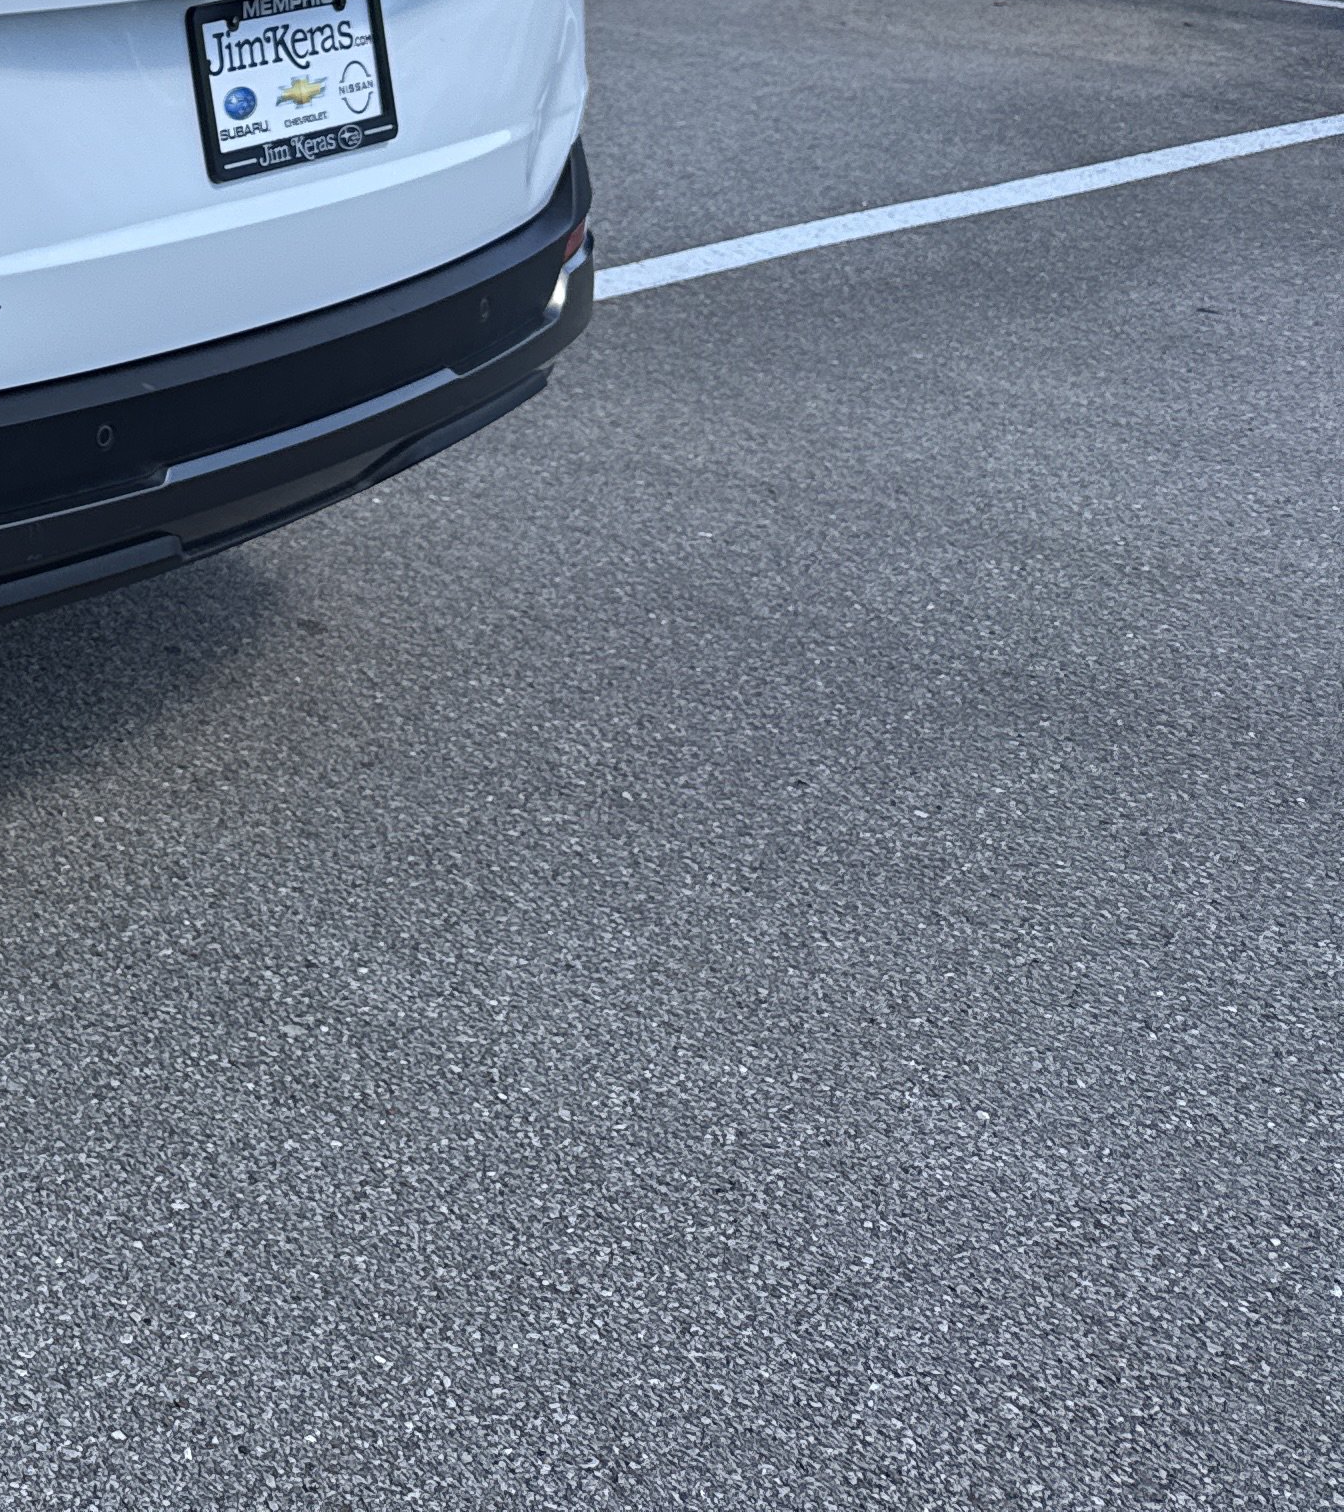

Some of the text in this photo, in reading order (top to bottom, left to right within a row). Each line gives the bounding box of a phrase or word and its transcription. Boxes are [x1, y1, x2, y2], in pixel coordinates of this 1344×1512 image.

[338, 80, 374, 95] NISSAN
[284, 111, 329, 128] CHEVROLET
[220, 121, 269, 141] SUBARU
[260, 133, 337, 167] Jim Keras
